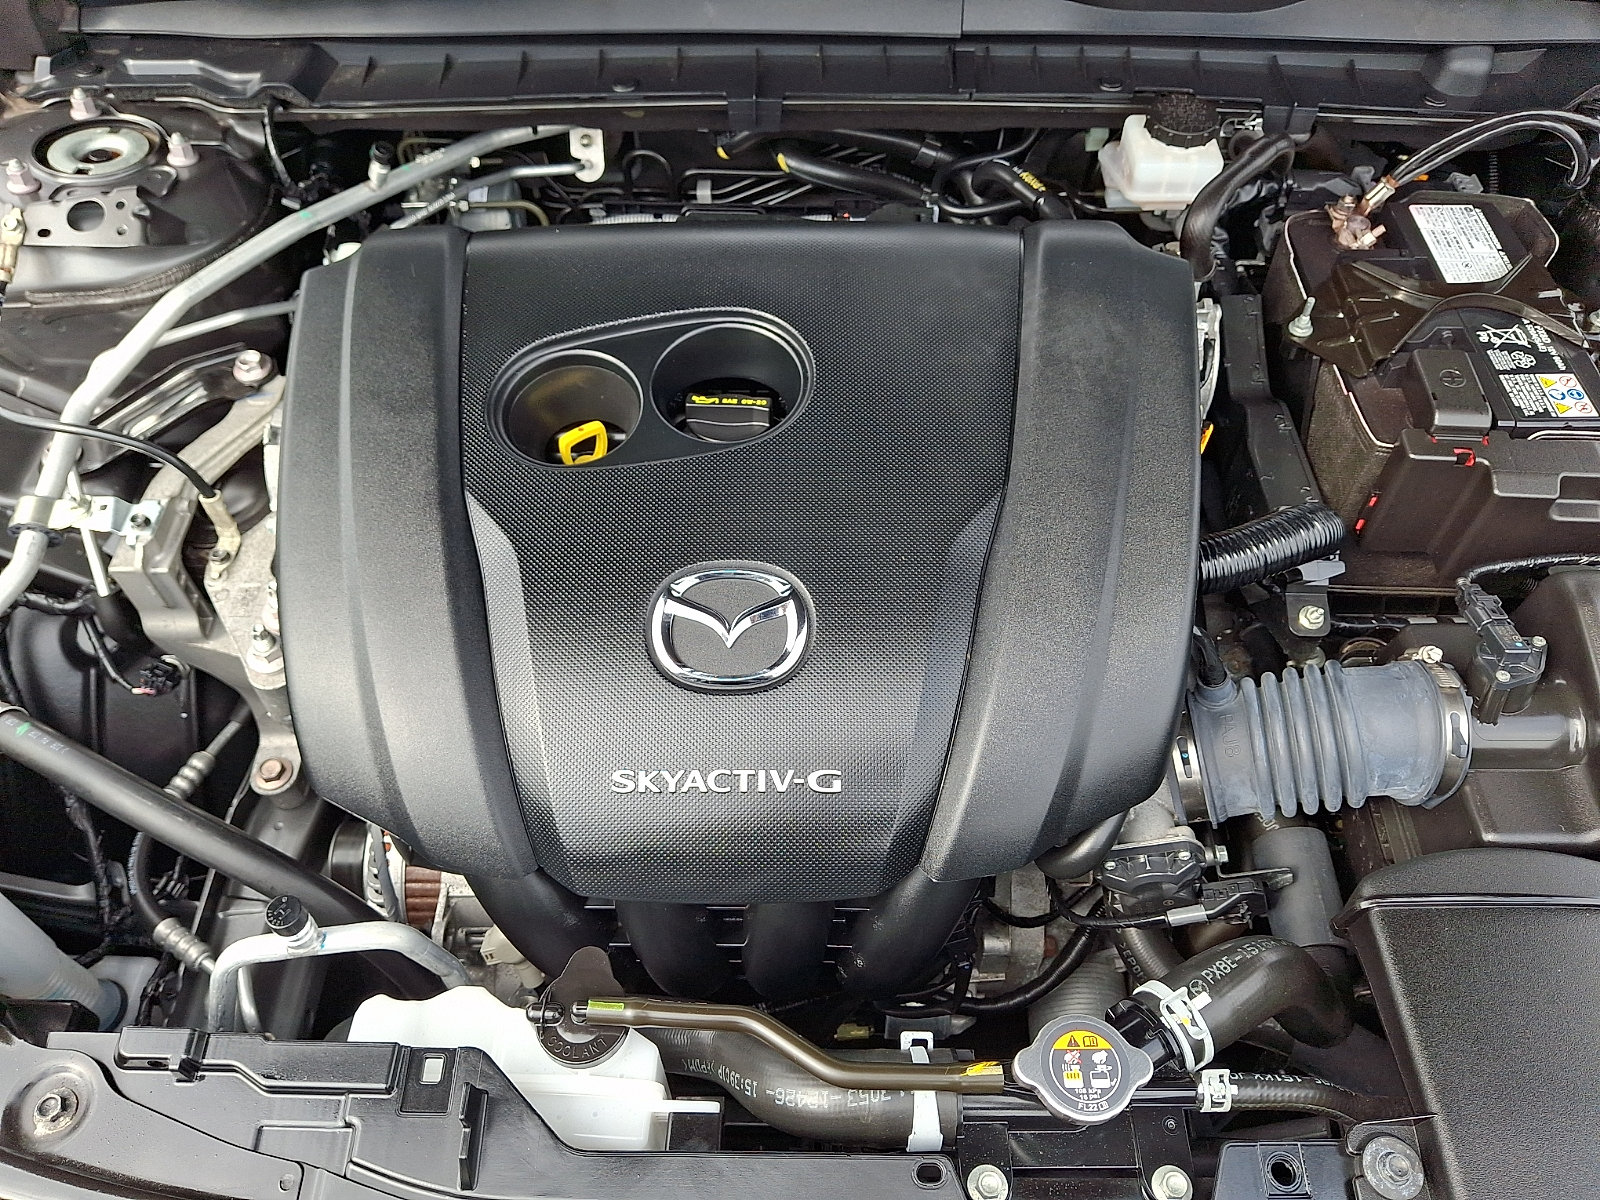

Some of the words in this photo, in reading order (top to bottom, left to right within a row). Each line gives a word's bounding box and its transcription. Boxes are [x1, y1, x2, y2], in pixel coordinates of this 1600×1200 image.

[611, 769, 842, 794] SKYACTIV-G
[547, 1036, 608, 1059] COOLANT
[1077, 1102, 1098, 1112] FL22
